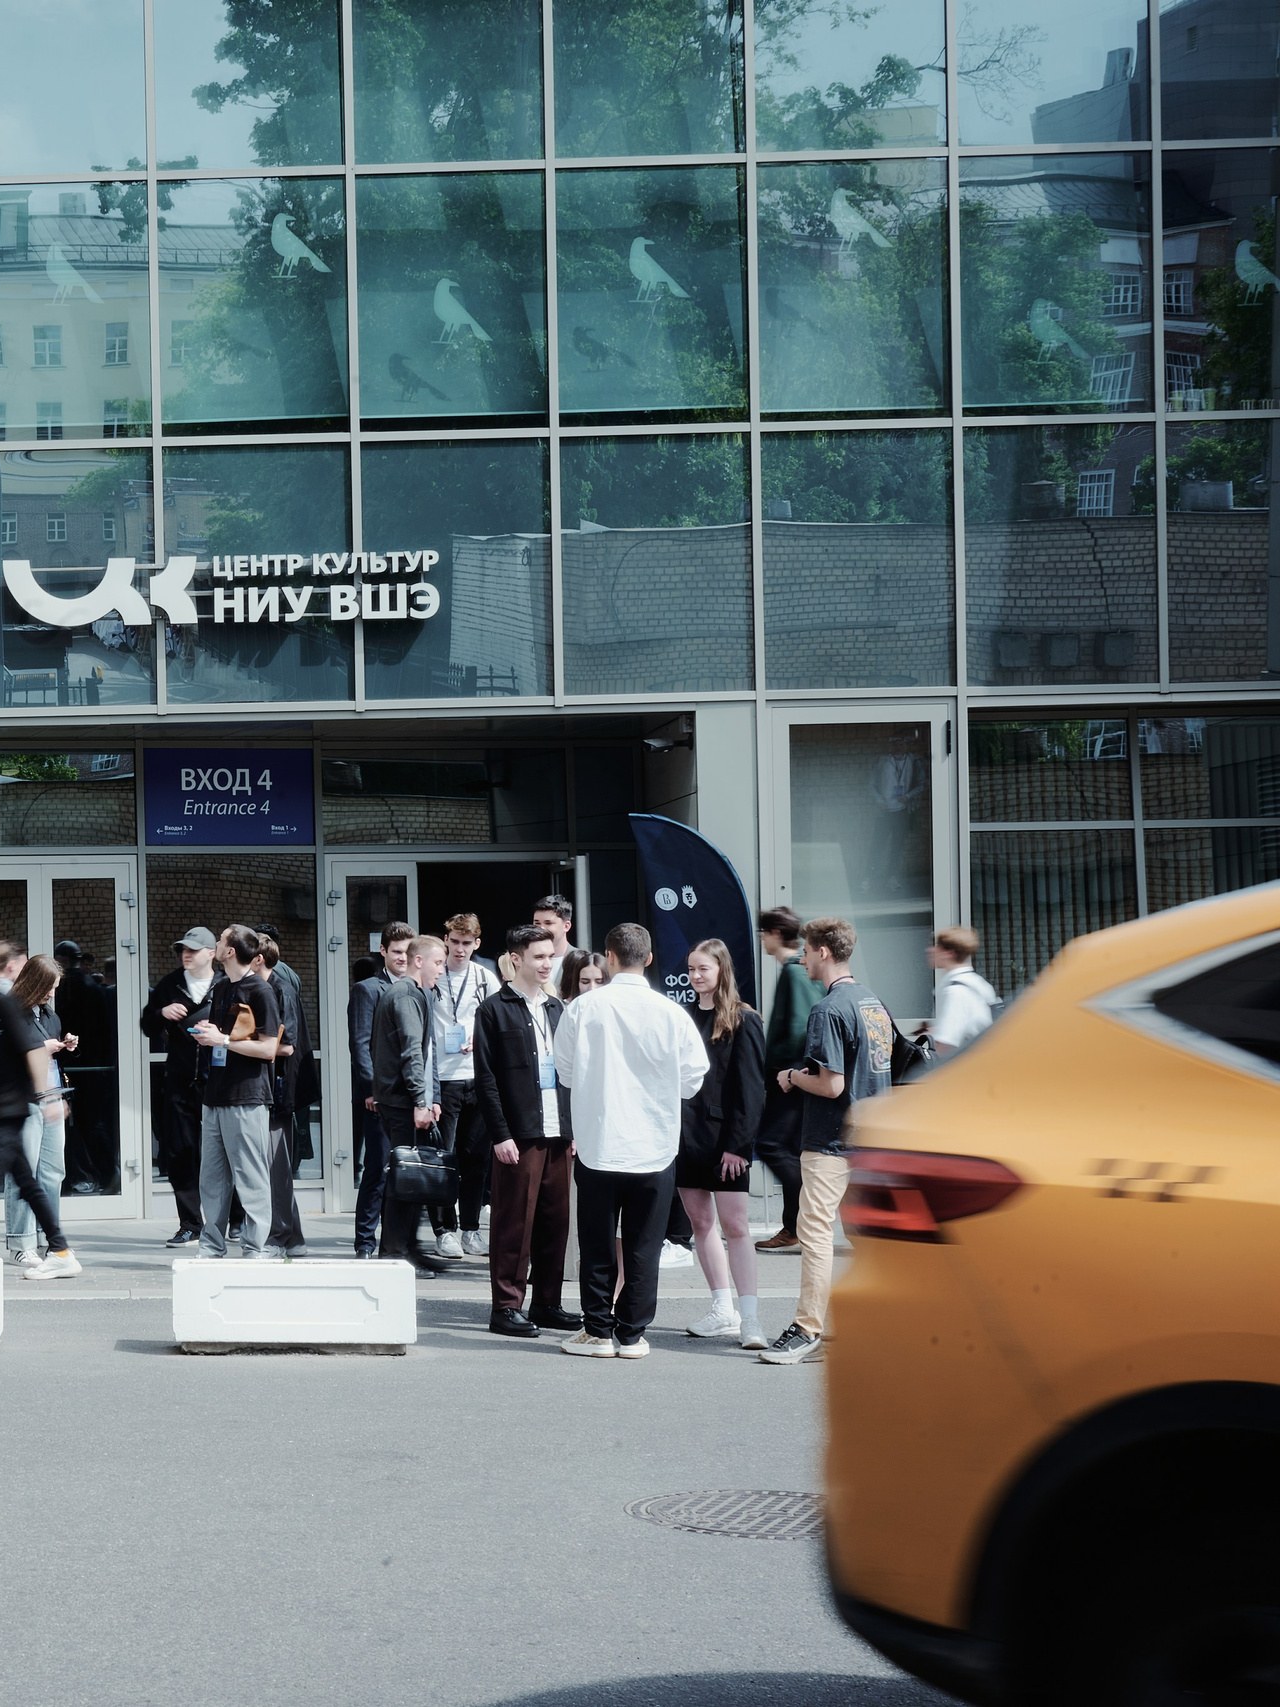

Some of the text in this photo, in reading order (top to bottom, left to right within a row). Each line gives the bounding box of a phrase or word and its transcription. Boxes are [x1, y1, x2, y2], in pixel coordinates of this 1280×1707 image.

[213, 550, 440, 581] ЦЕНТР КУЛЬТУР
[214, 582, 441, 623] НИУ ВШЭ
[180, 768, 273, 796] ВХОД 4
[183, 799, 270, 816] Entrance 4
[666, 989, 696, 1003] БИЗ
